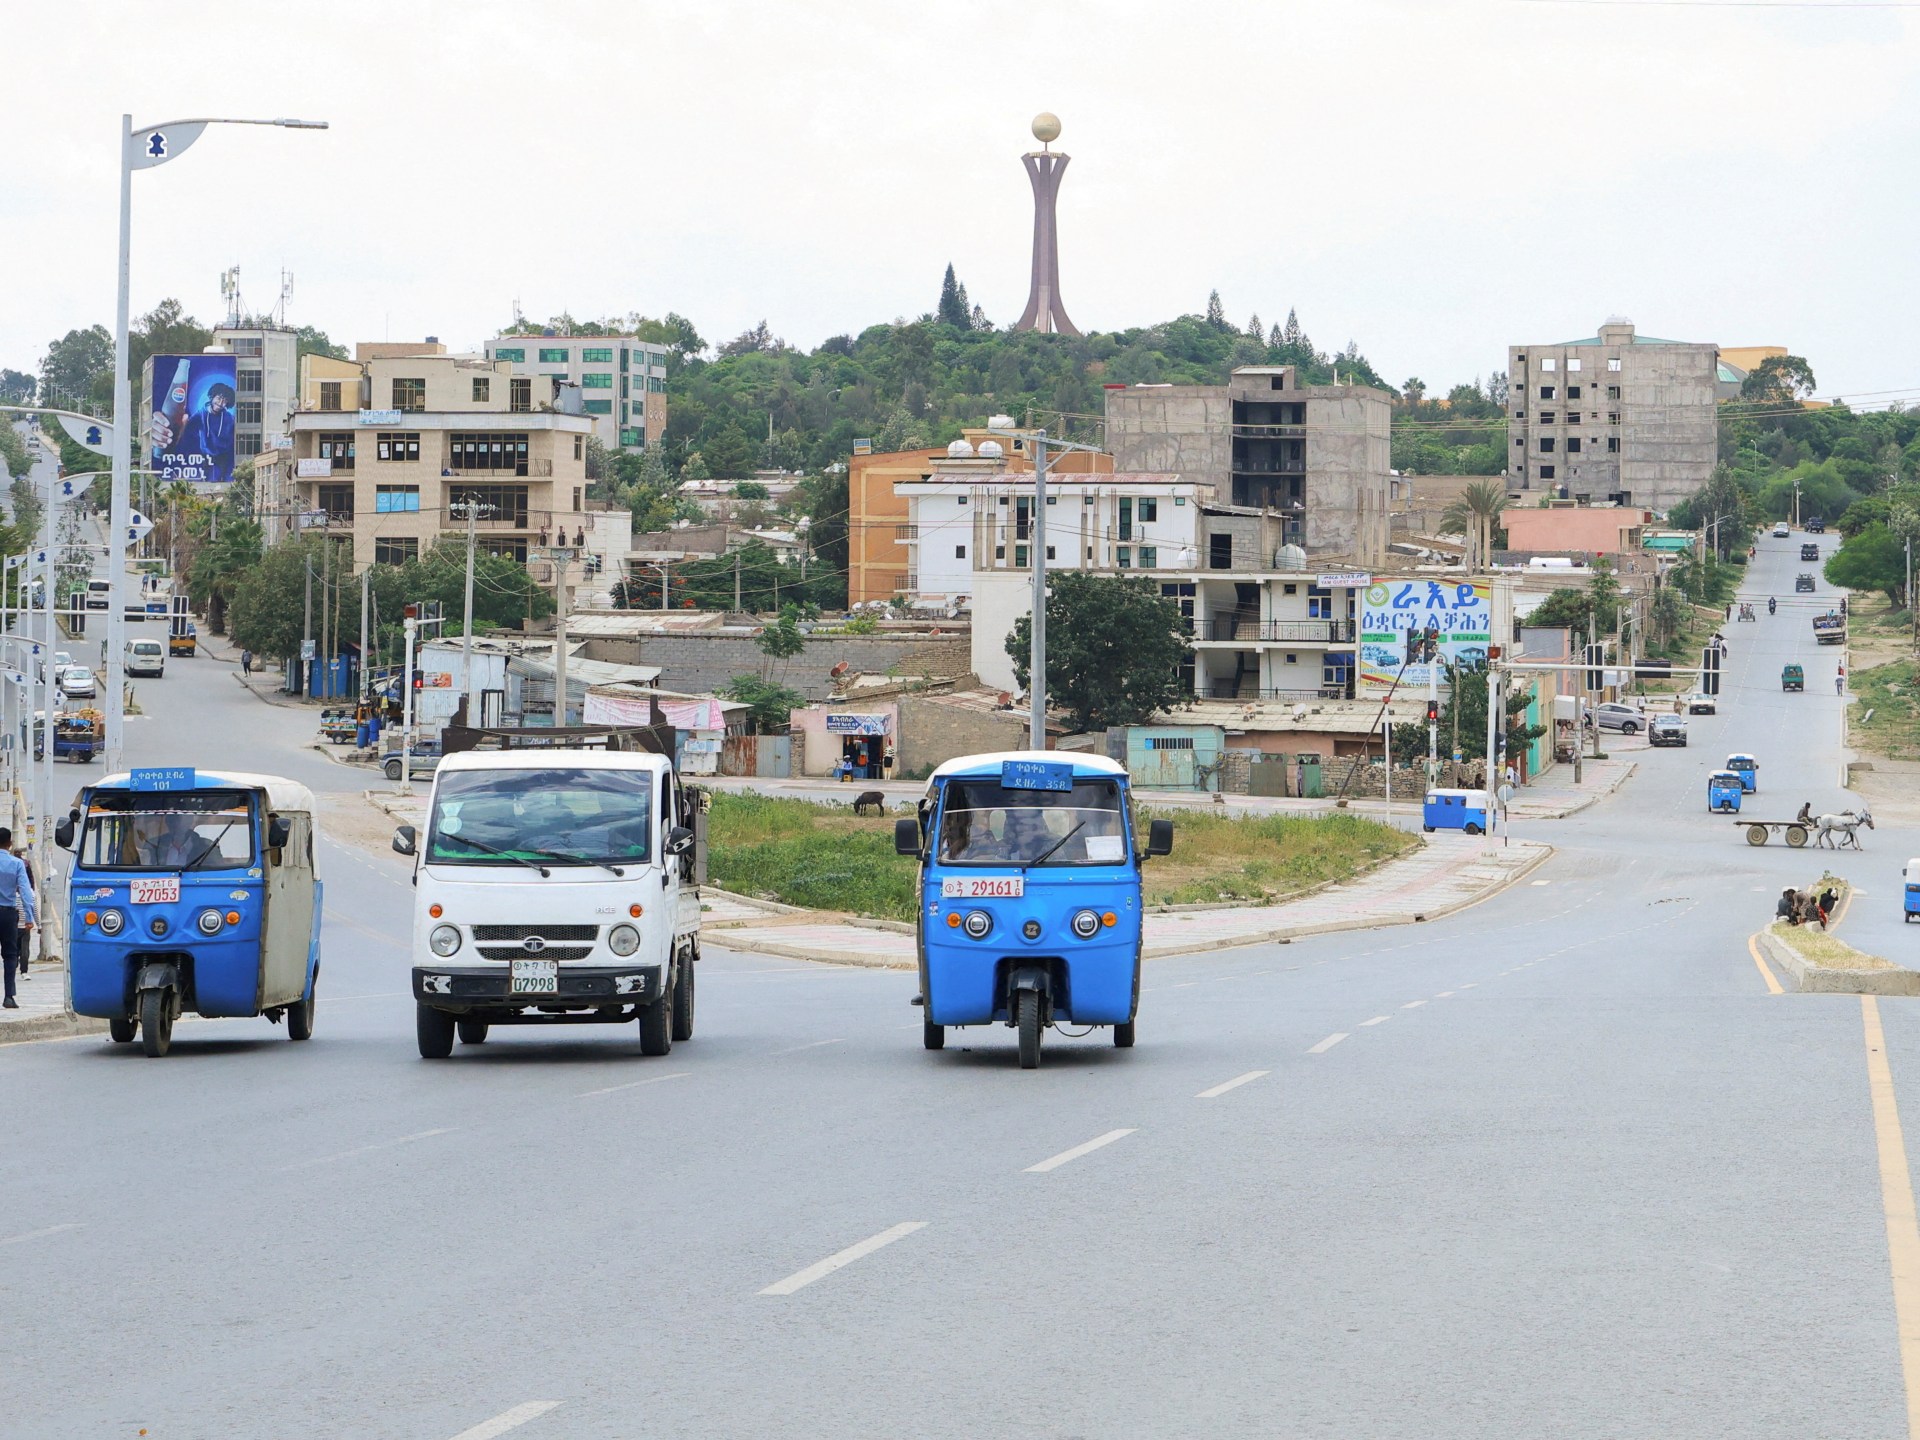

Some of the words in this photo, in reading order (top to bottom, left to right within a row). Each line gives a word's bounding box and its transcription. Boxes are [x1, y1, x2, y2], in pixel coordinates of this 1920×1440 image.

[162, 453, 214, 466] ጥዒሙኒ
[161, 466, 207, 479] ድገመኒ
[1392, 581, 1480, 610] ራእይ
[1362, 611, 1418, 632] ዕቋርን
[1427, 612, 1490, 632] ልቓሕን
[153, 780, 170, 790] 101
[1045, 780, 1066, 790] 358
[138, 887, 177, 903] 27053
[971, 880, 1012, 896] 29161
[514, 977, 554, 992] 07998
